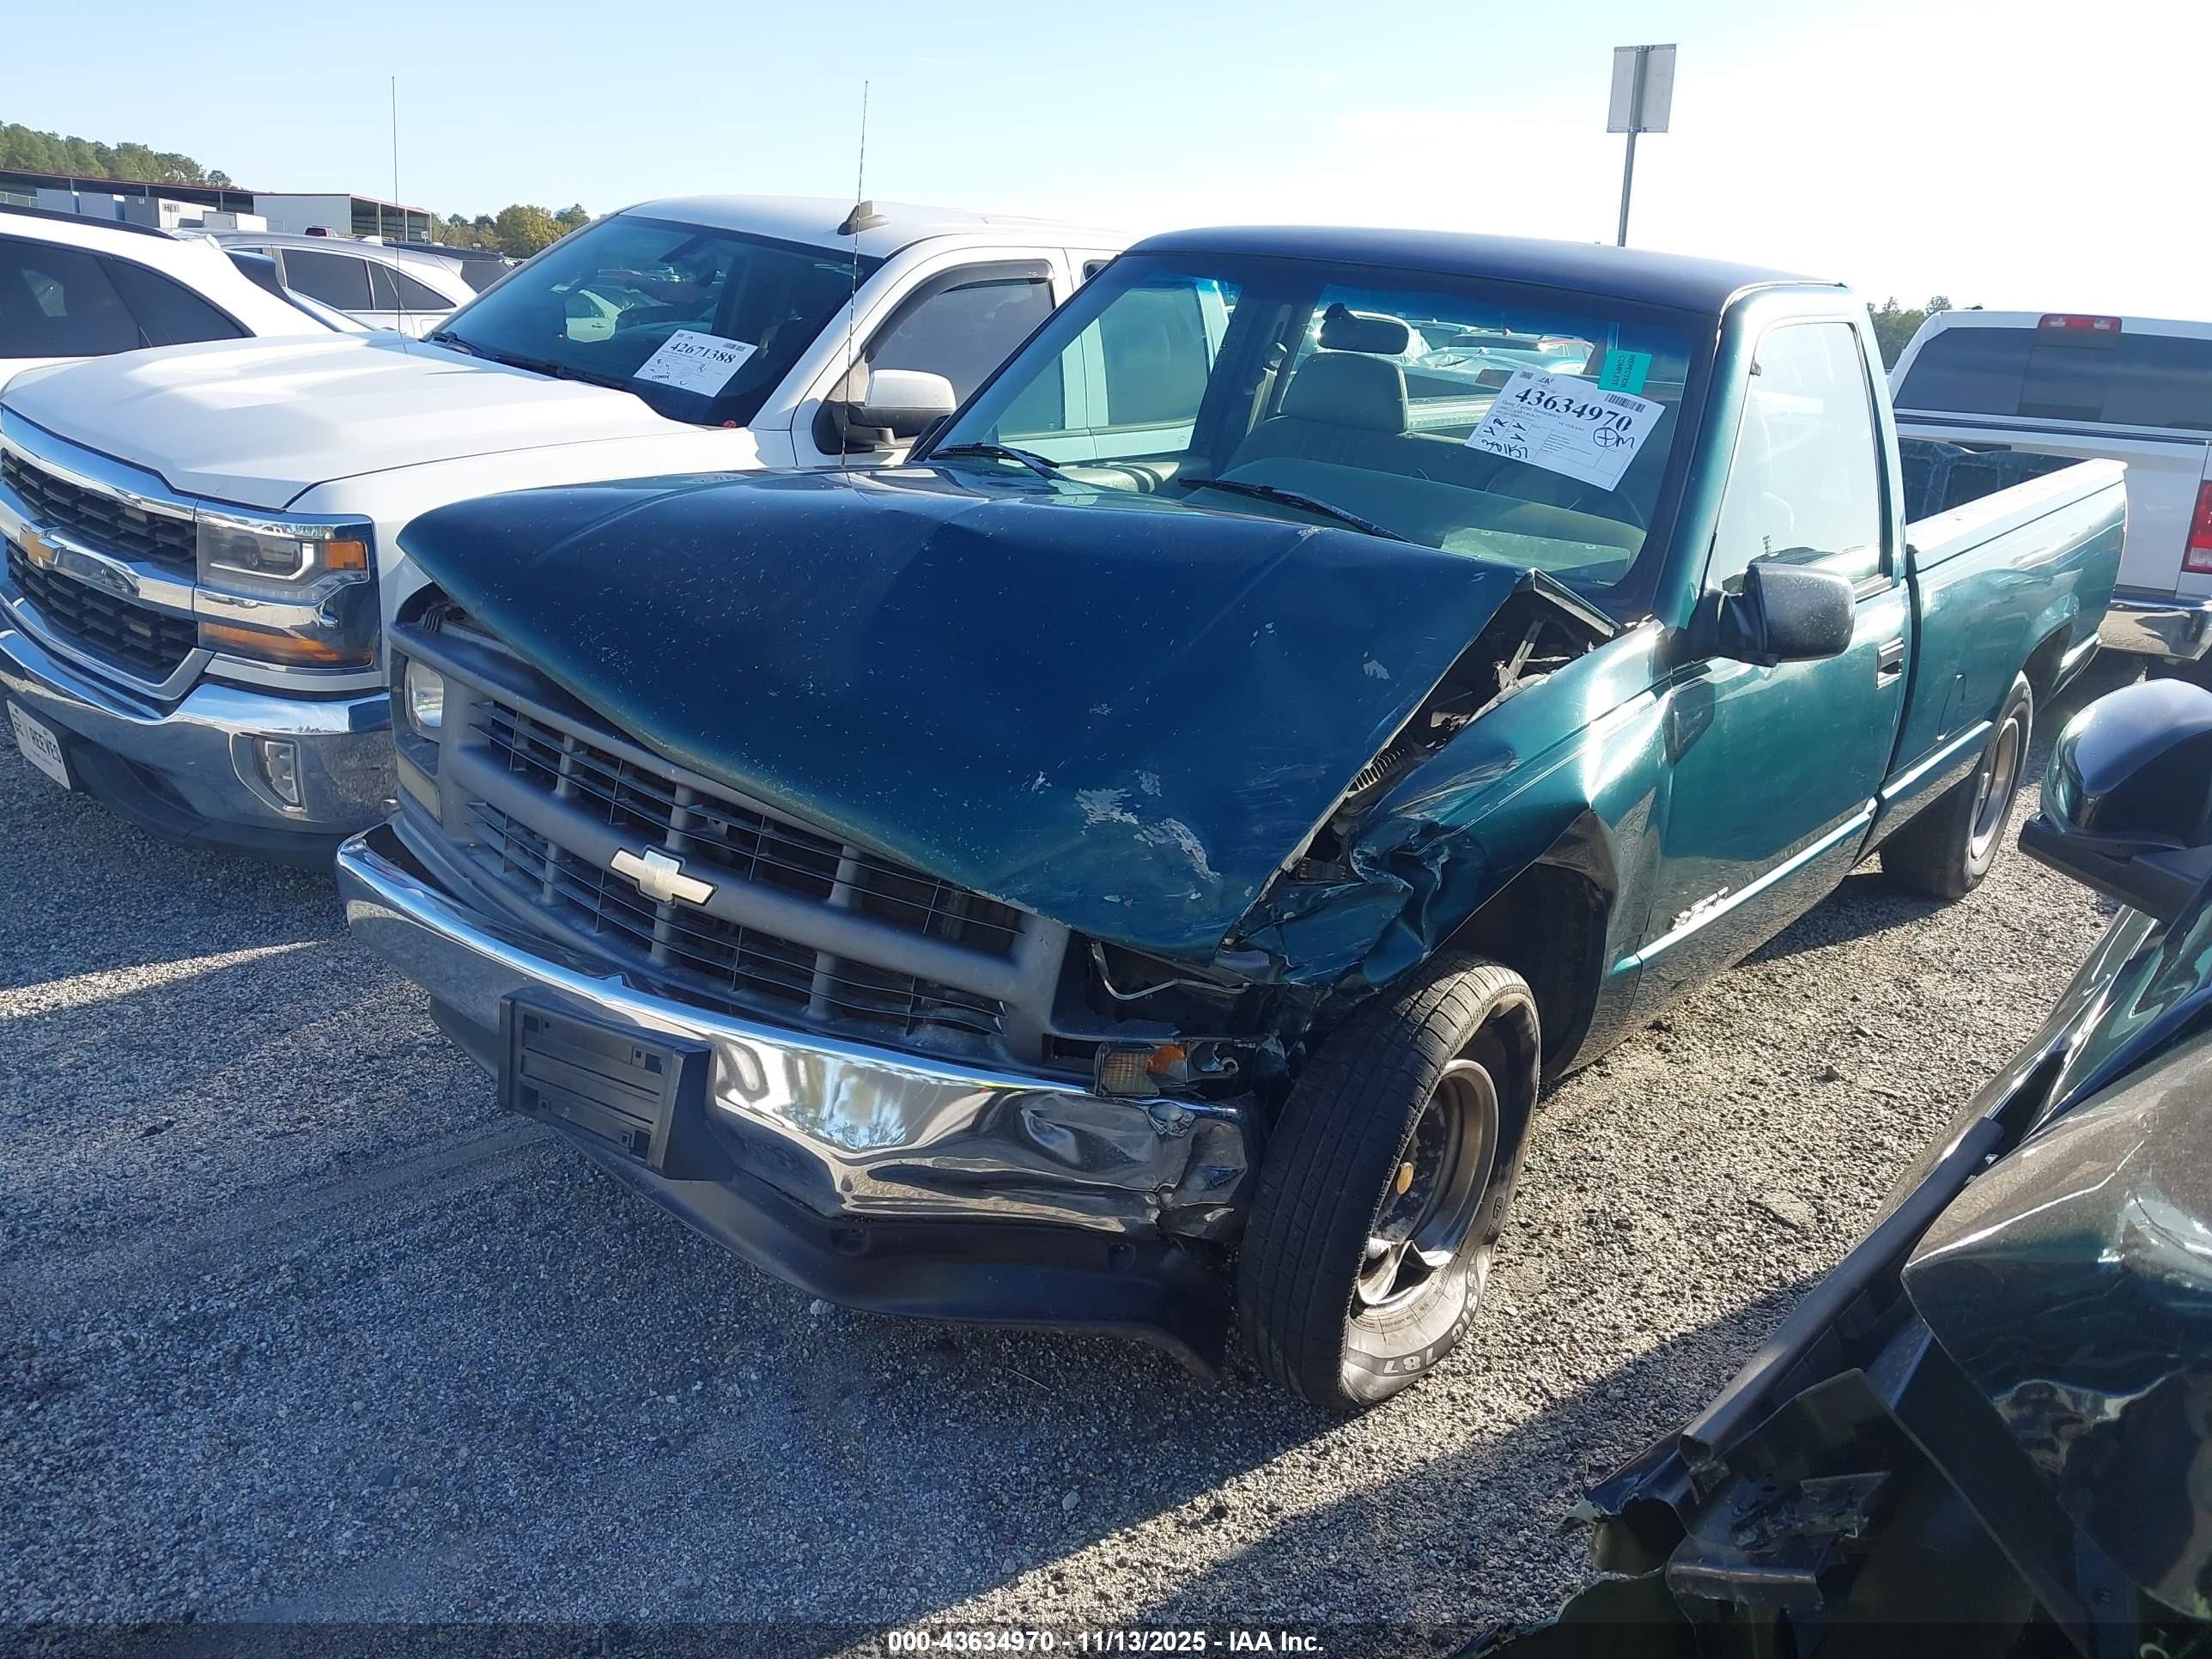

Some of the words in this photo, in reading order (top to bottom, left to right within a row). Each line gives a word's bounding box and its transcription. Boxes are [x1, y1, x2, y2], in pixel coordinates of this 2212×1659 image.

[670, 342, 737, 364] 42671388
[1611, 356, 1626, 386] COMPLETE
[1621, 354, 1636, 389] INSPECTION
[1515, 387, 1633, 432] 43634970
[1516, 402, 1533, 411] Farm
[1534, 406, 1561, 419] Insurance
